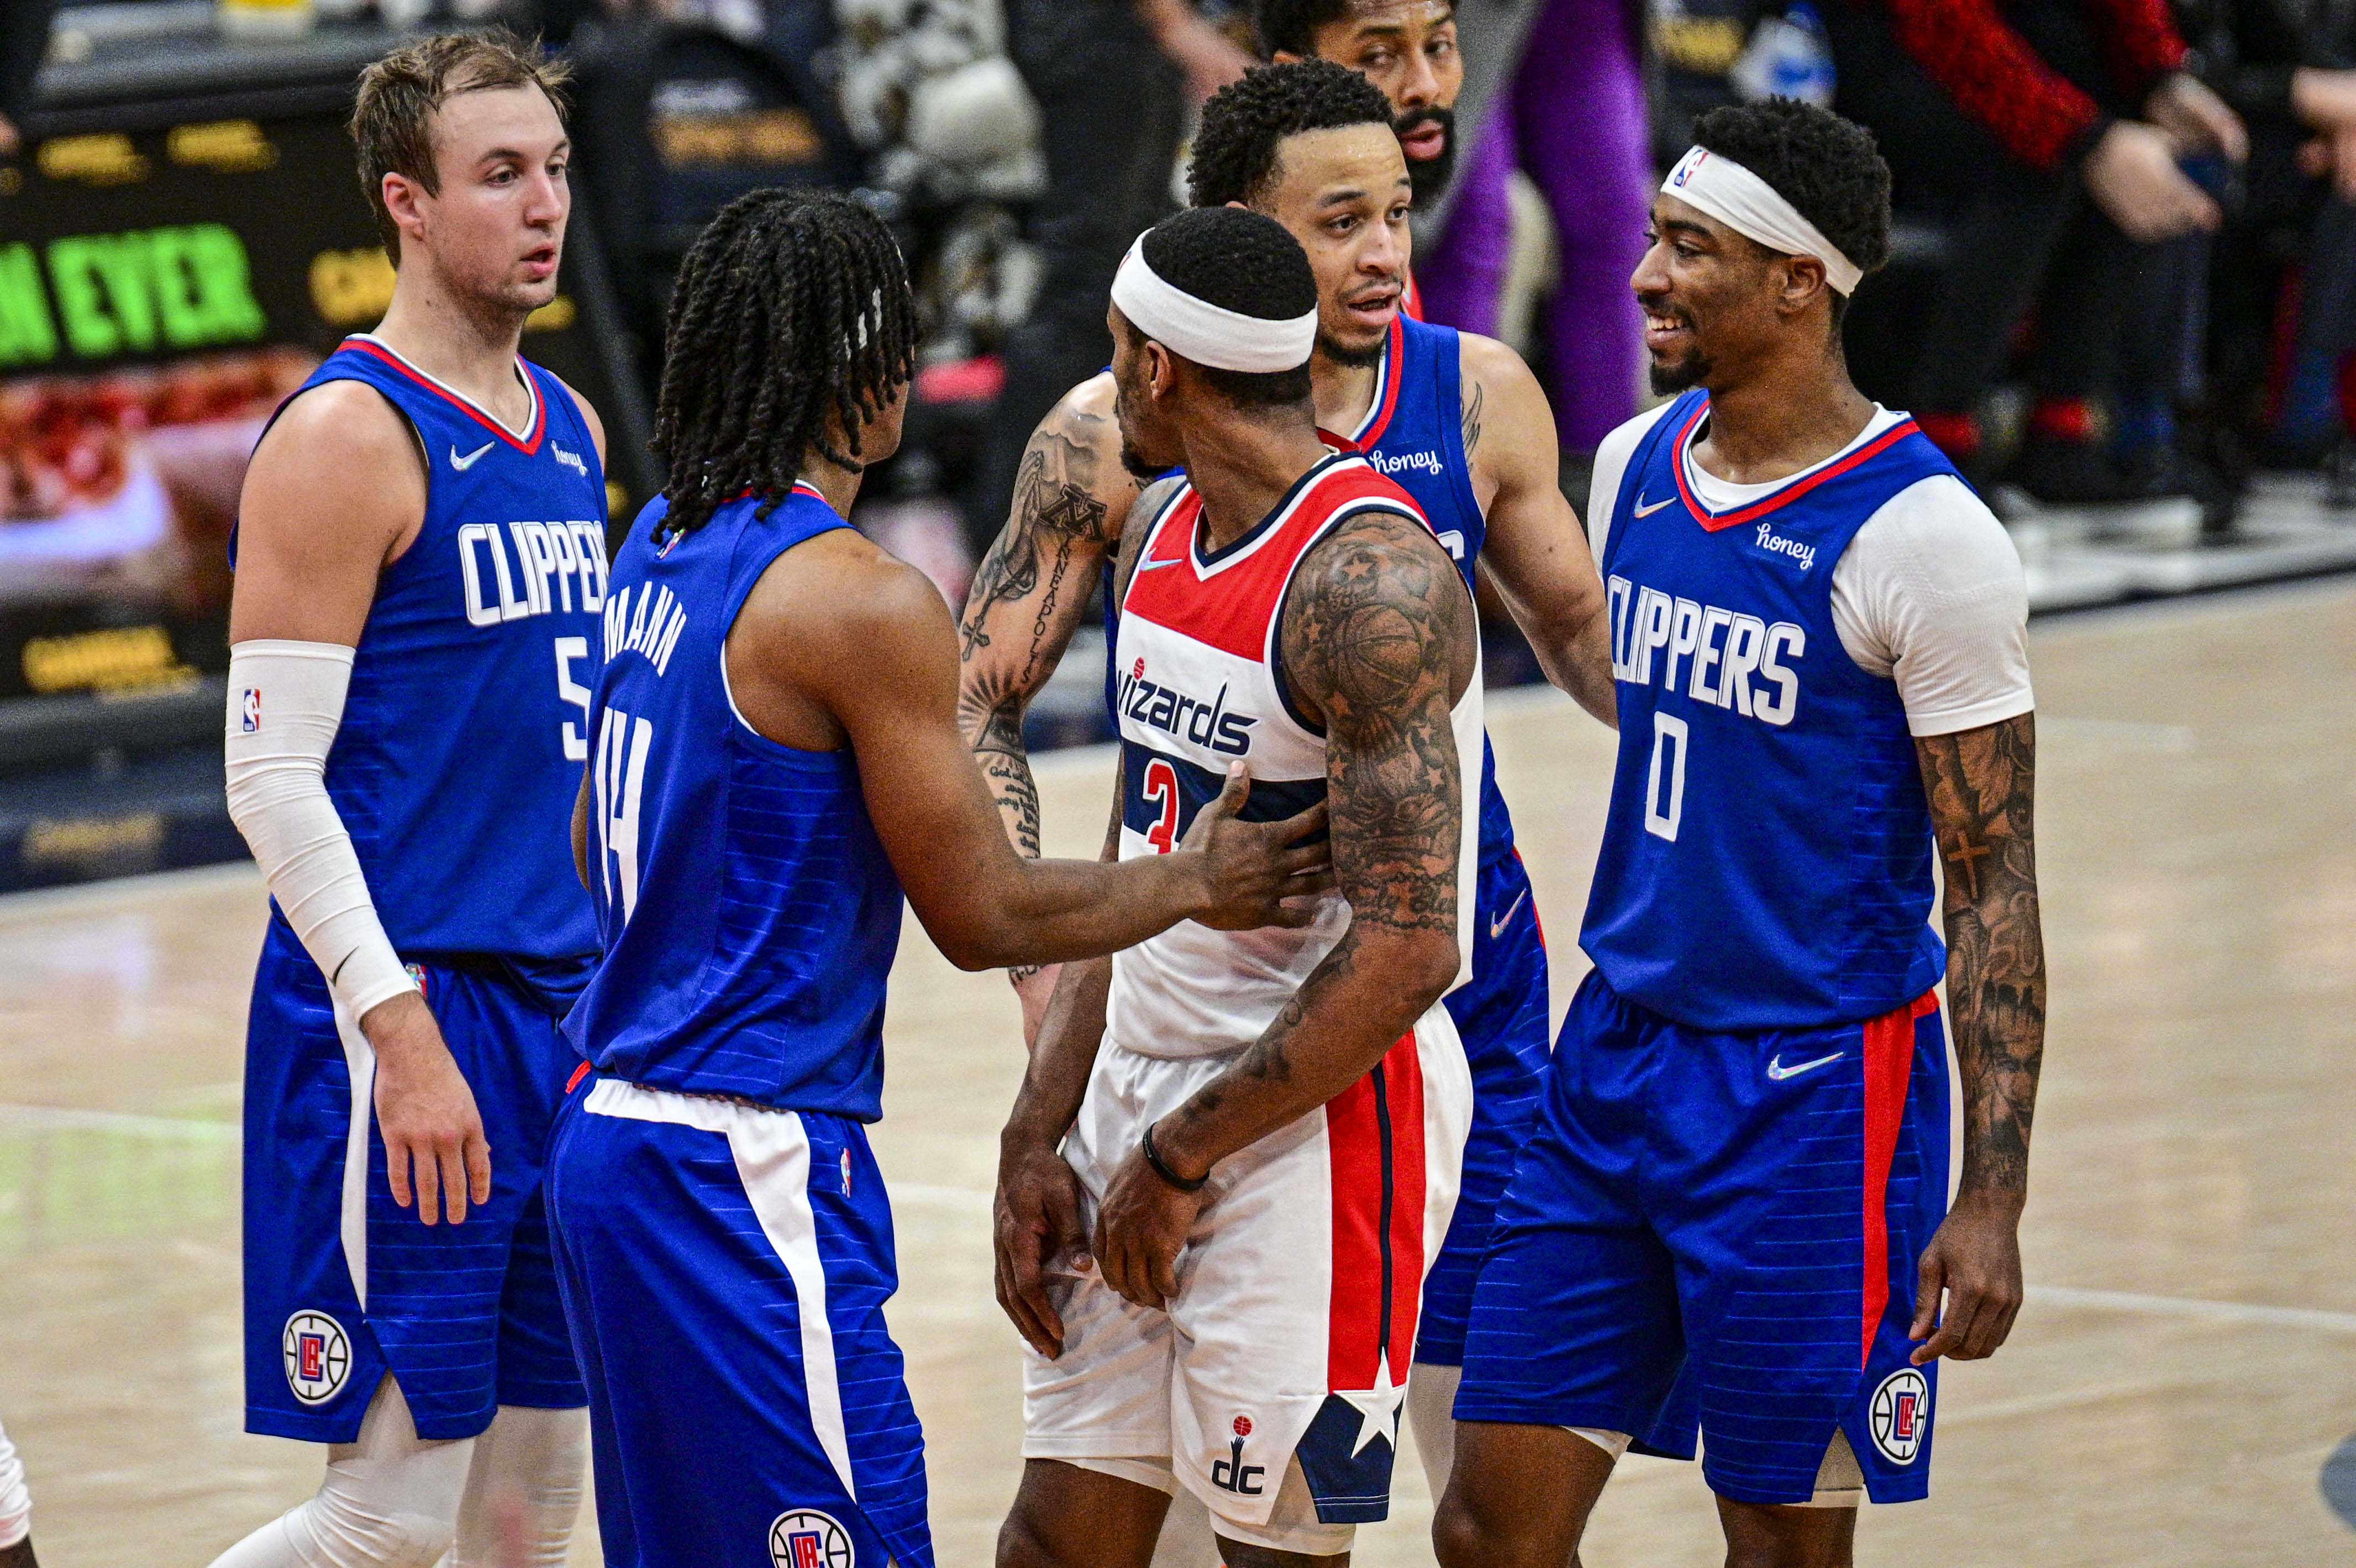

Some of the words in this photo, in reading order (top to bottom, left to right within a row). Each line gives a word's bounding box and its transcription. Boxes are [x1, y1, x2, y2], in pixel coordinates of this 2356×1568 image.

[551, 440, 588, 476] honey
[1369, 449, 1443, 475] honey
[1757, 523, 1816, 570] honey
[605, 581, 687, 677] MANN
[1608, 573, 1806, 726] CLIPPERS
[554, 636, 591, 761] 5
[595, 706, 653, 928] 14
[1644, 711, 1689, 842] 0
